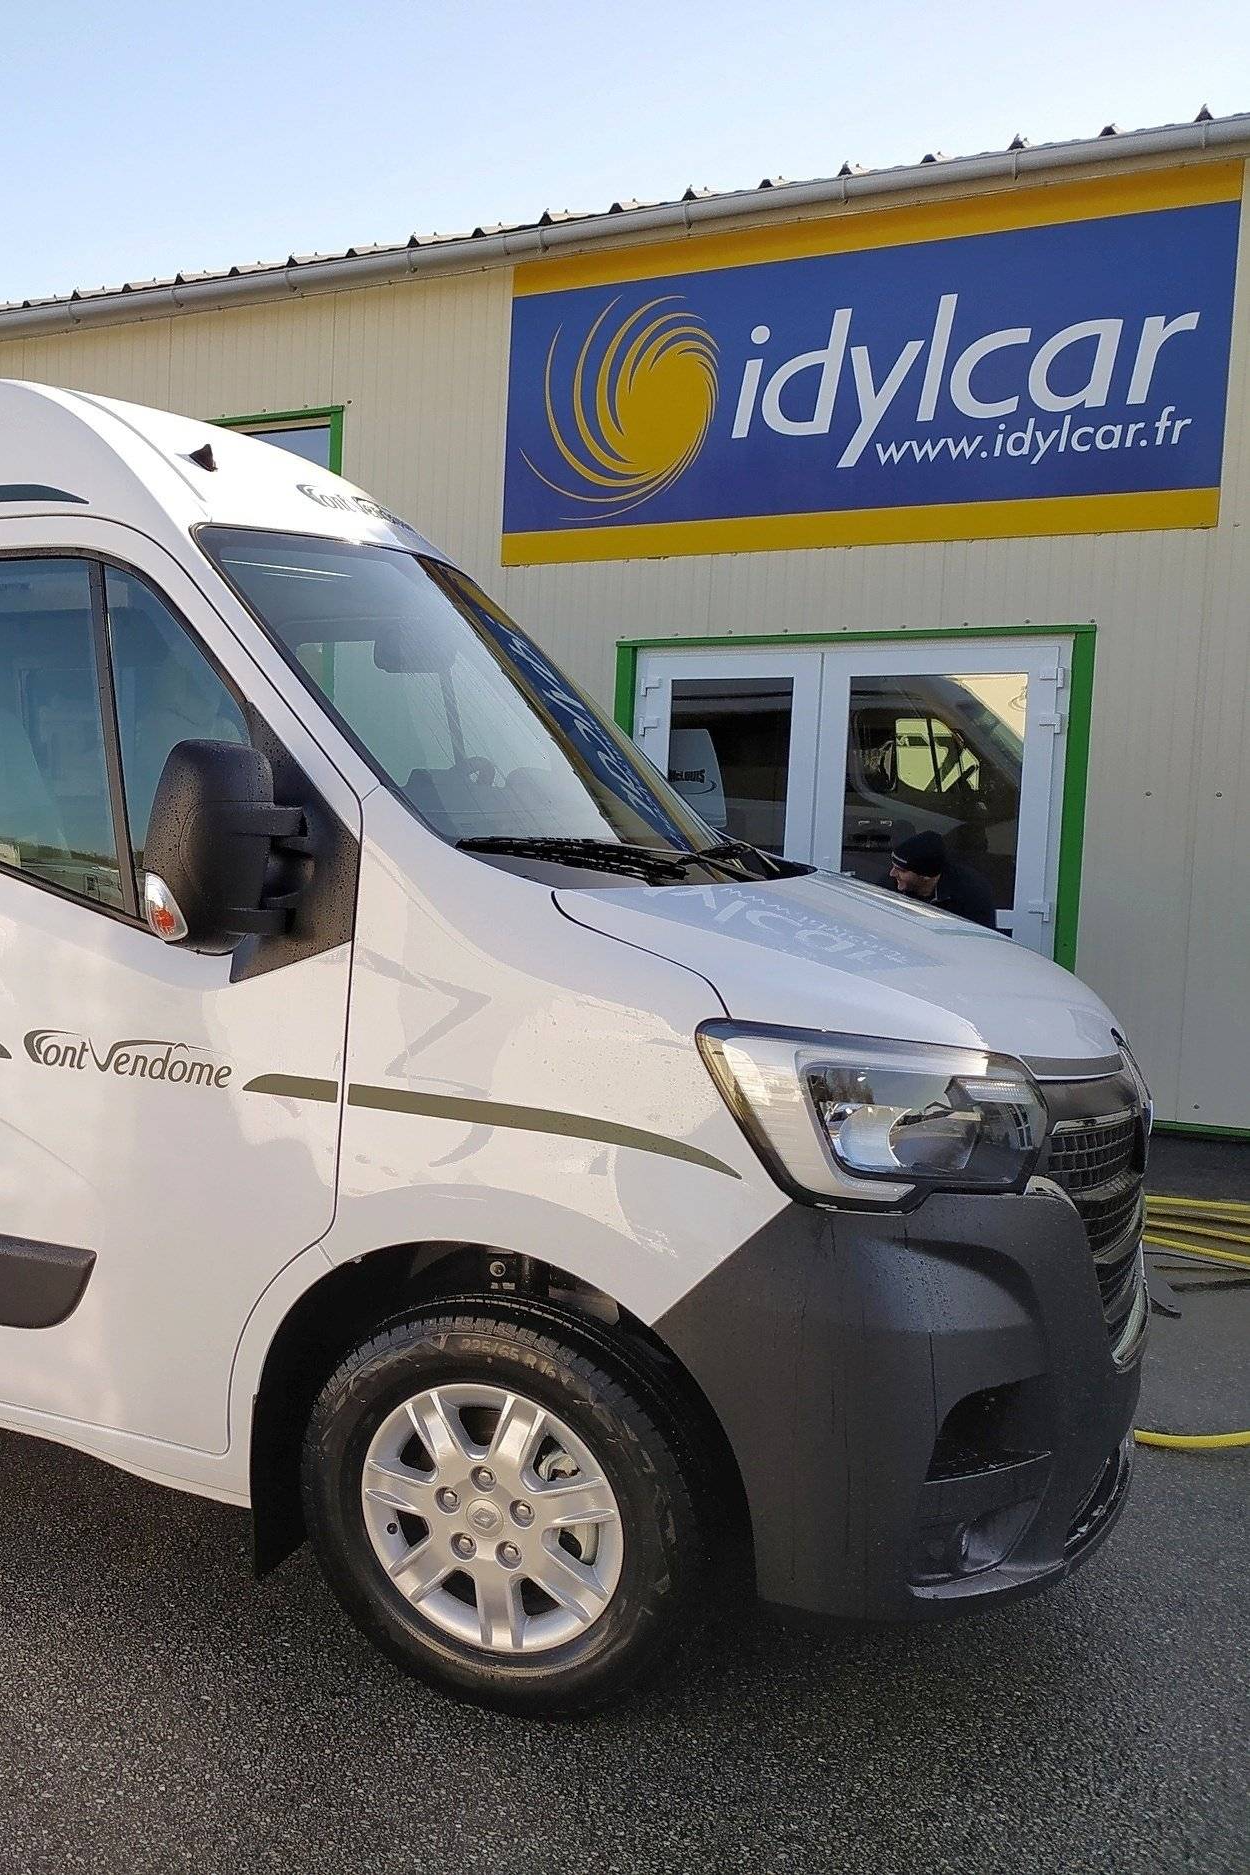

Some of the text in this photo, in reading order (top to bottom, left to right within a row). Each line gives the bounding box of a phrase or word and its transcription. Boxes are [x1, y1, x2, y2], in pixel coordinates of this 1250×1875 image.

[731, 293, 1200, 469] idylcar
[875, 405, 1193, 466] www.idylcar.fr
[88, 1037, 235, 1089] Vendôme
